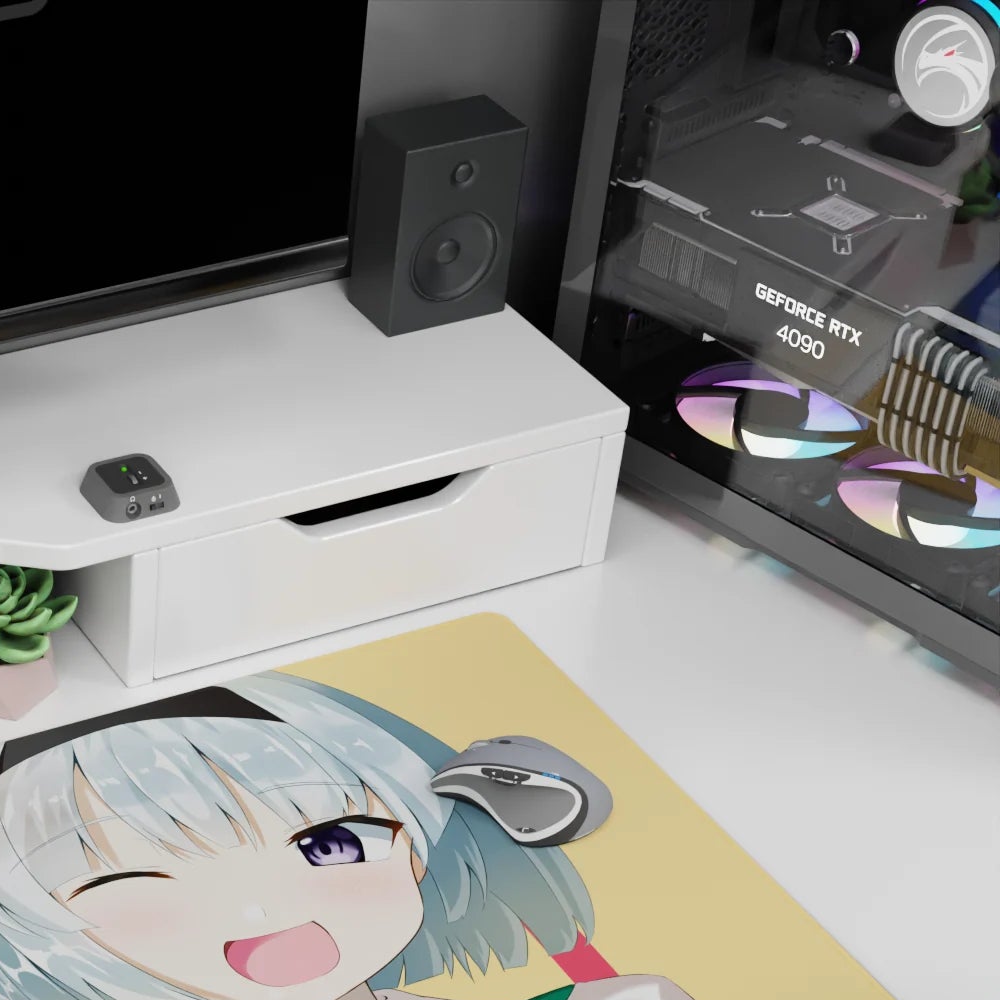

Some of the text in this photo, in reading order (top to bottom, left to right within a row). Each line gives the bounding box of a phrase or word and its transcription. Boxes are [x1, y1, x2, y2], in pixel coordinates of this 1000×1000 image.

[755, 282, 863, 347] GEFORCE RTX
[776, 324, 825, 360] 4090
